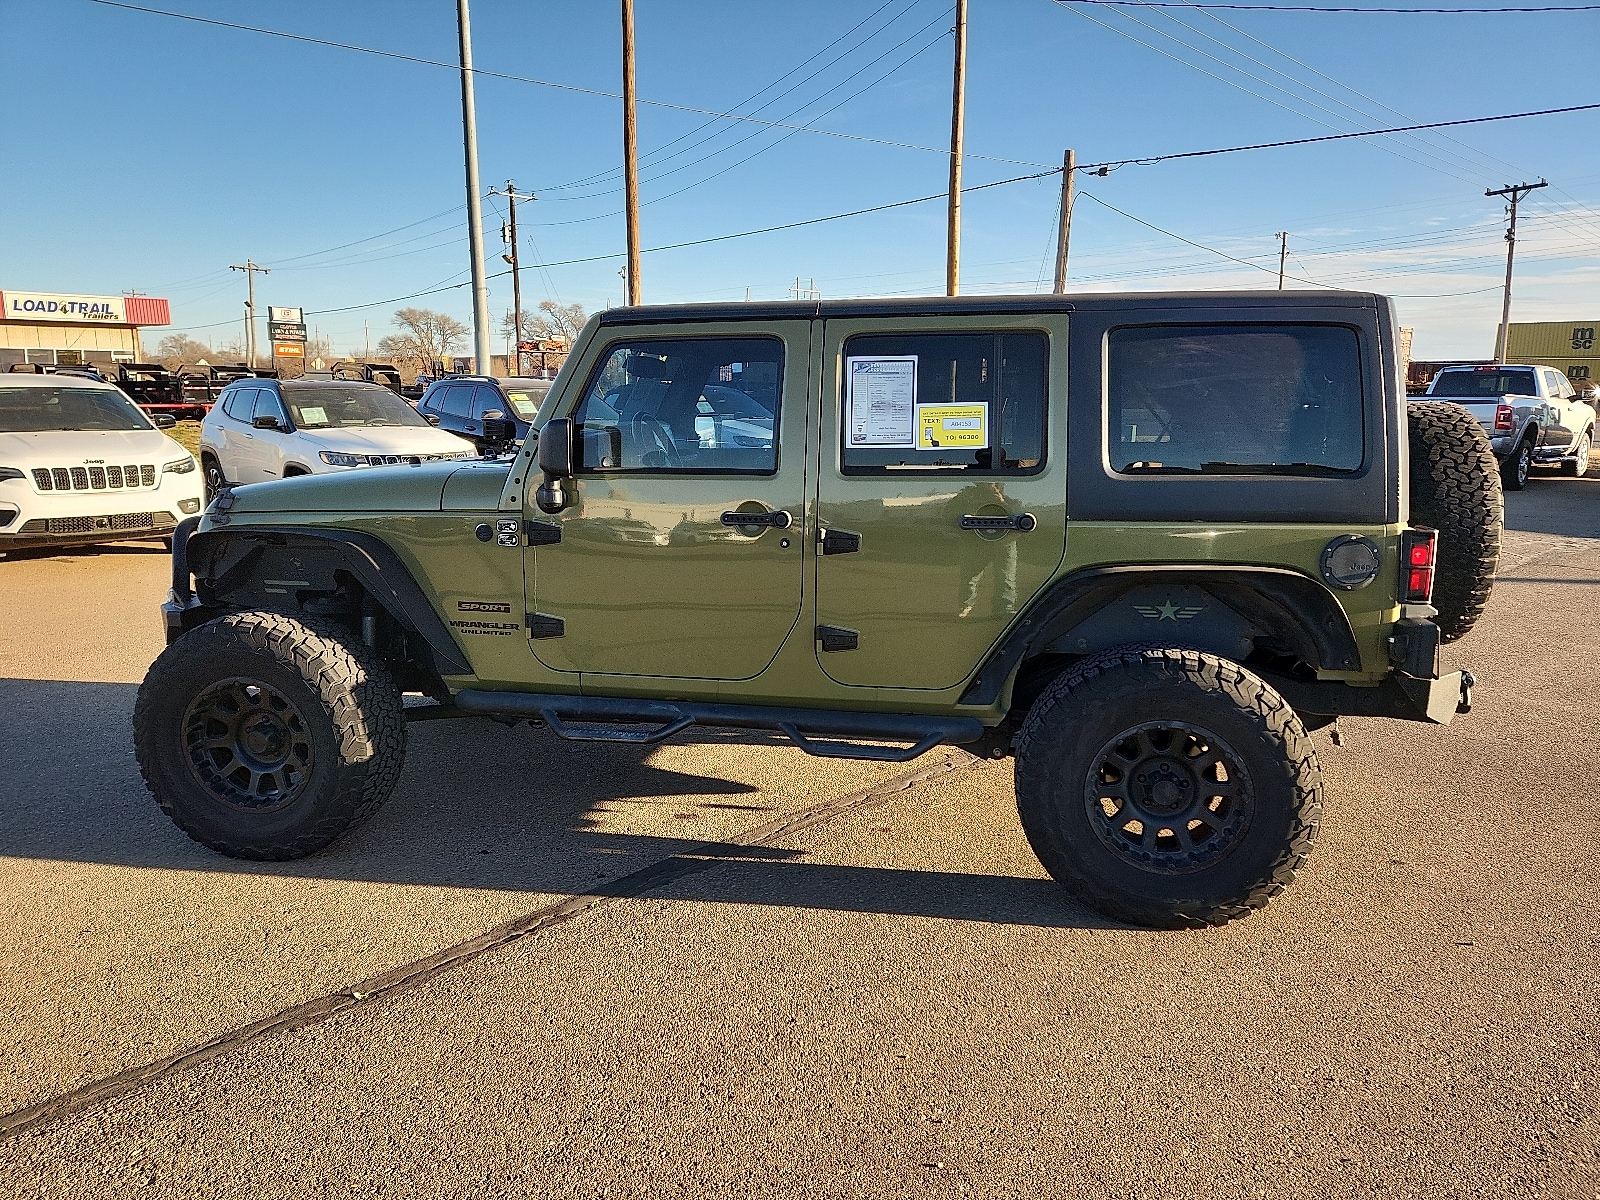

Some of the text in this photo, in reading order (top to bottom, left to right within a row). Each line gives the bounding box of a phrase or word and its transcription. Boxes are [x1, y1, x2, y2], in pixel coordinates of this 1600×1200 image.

[13, 300, 113, 314] LOAD TRAIL
[83, 312, 119, 320] Trailers
[1350, 563, 1371, 571] Jeep
[460, 603, 508, 612] SPORT
[449, 620, 520, 631] WRANGLER
